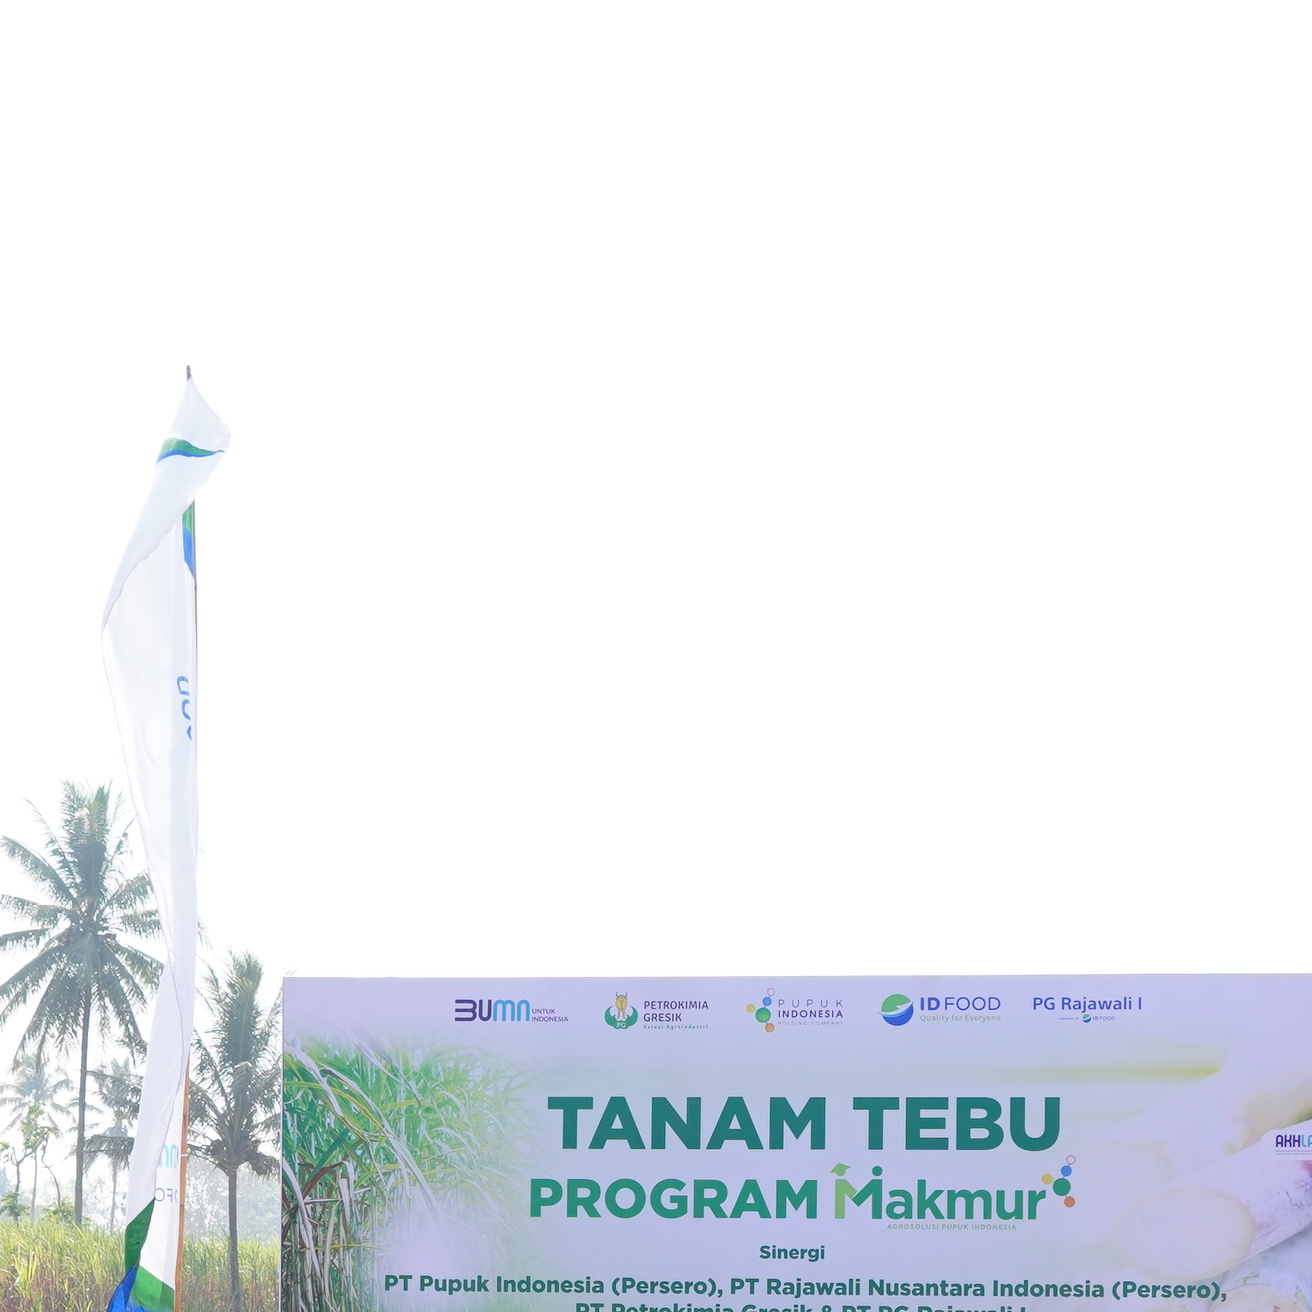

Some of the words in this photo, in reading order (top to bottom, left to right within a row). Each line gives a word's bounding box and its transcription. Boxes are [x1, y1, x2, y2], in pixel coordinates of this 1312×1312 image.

[643, 1000, 709, 1010] PETROKIMIA
[778, 999, 844, 1008] PUPUK
[920, 997, 941, 1011] ID
[944, 997, 1001, 1011] FOOD
[1033, 997, 1055, 1010] PG
[1061, 996, 1132, 1013] Rajawali
[1138, 996, 1142, 1010] I
[643, 1012, 682, 1022] GRESIK
[778, 1010, 844, 1018] INDONESIA
[920, 1014, 949, 1023] Quality
[951, 1014, 963, 1022] for
[964, 1014, 1001, 1023] Everyone
[547, 1096, 826, 1150] TANAM
[853, 1096, 1060, 1151] TEBU
[530, 1178, 818, 1219] PROGRAM
[834, 1166, 1046, 1221] Makmur
[759, 1245, 825, 1262] Sinergi
[384, 1276, 412, 1292] PT
[420, 1275, 489, 1296] Pupuk
[497, 1275, 604, 1294] Indonesia
[611, 1276, 723, 1297] (Persero),
[730, 1279, 759, 1295] PT
[767, 1278, 860, 1300] Rajawali
[868, 1279, 985, 1297] Nusantara
[993, 1280, 1104, 1298] Indonesia
[1112, 1280, 1227, 1302] (Persero),
